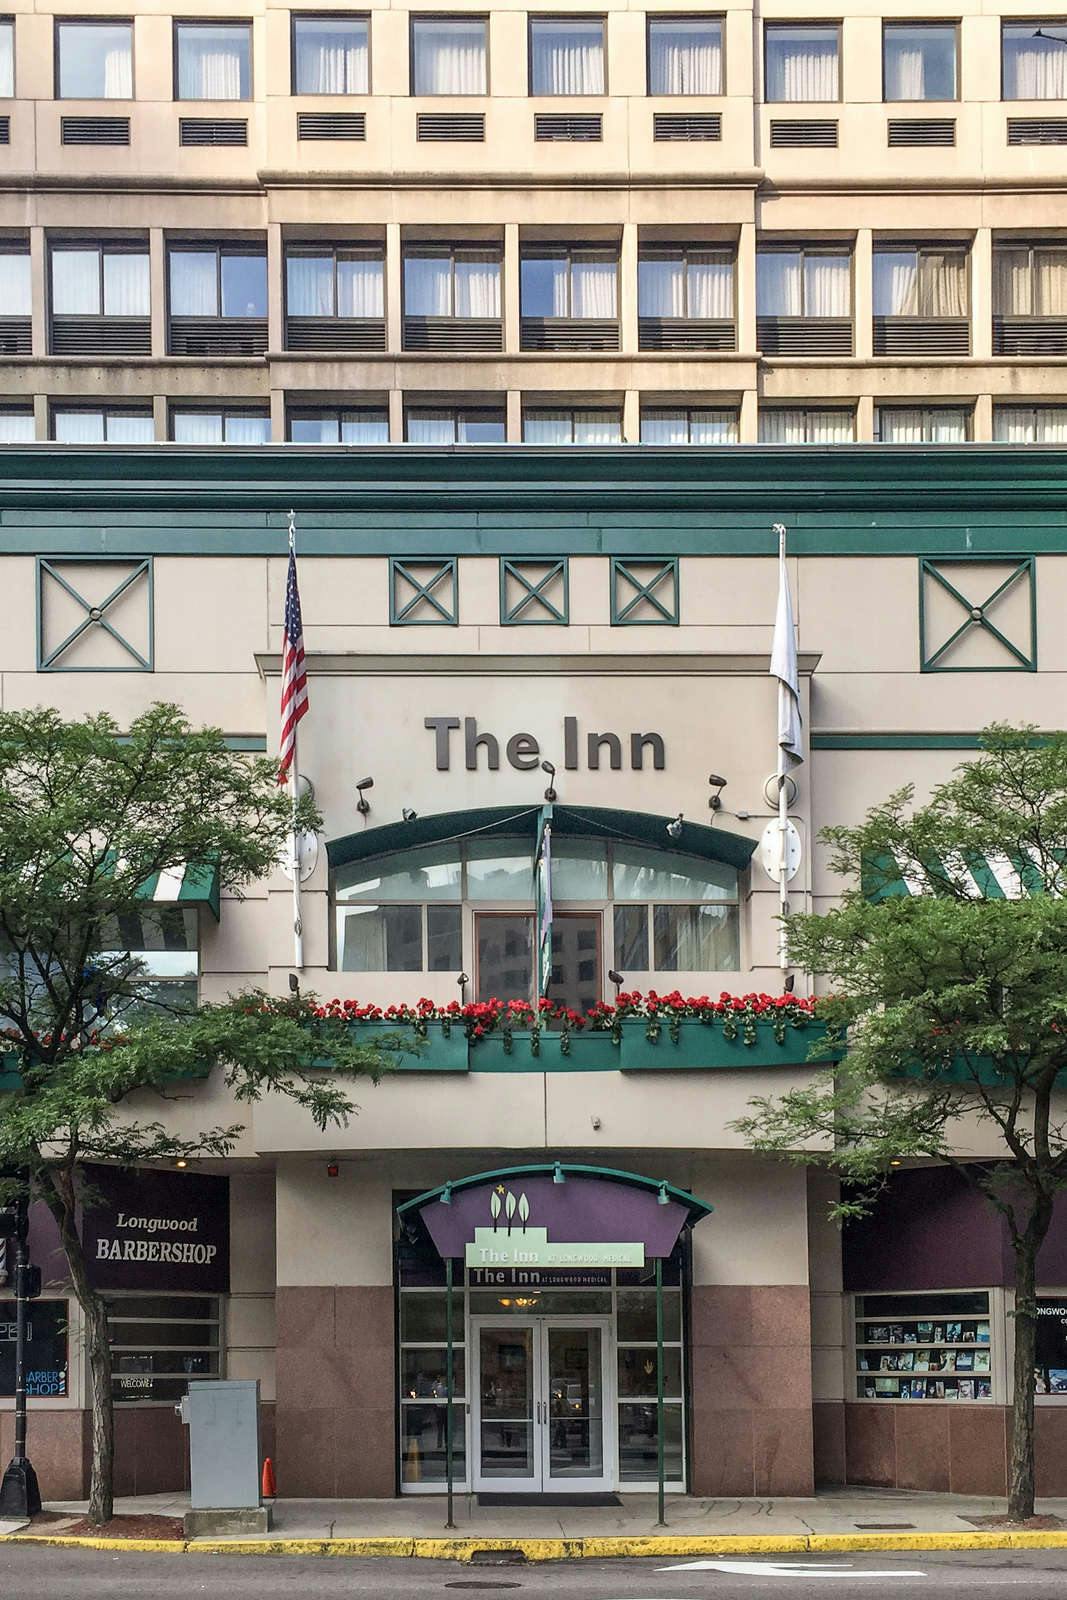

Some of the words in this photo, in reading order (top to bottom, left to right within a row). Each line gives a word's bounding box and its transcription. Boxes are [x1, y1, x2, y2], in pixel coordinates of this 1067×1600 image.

[424, 717, 540, 770] The
[564, 716, 665, 770] Inn
[116, 1213, 198, 1232] Longwood
[96, 1239, 217, 1264] BARBERSHOP
[480, 1249, 508, 1263] The
[513, 1249, 538, 1263] Inn
[474, 1268, 505, 1283] The
[511, 1268, 540, 1283] Inn
[26, 1371, 58, 1383] ARBER
